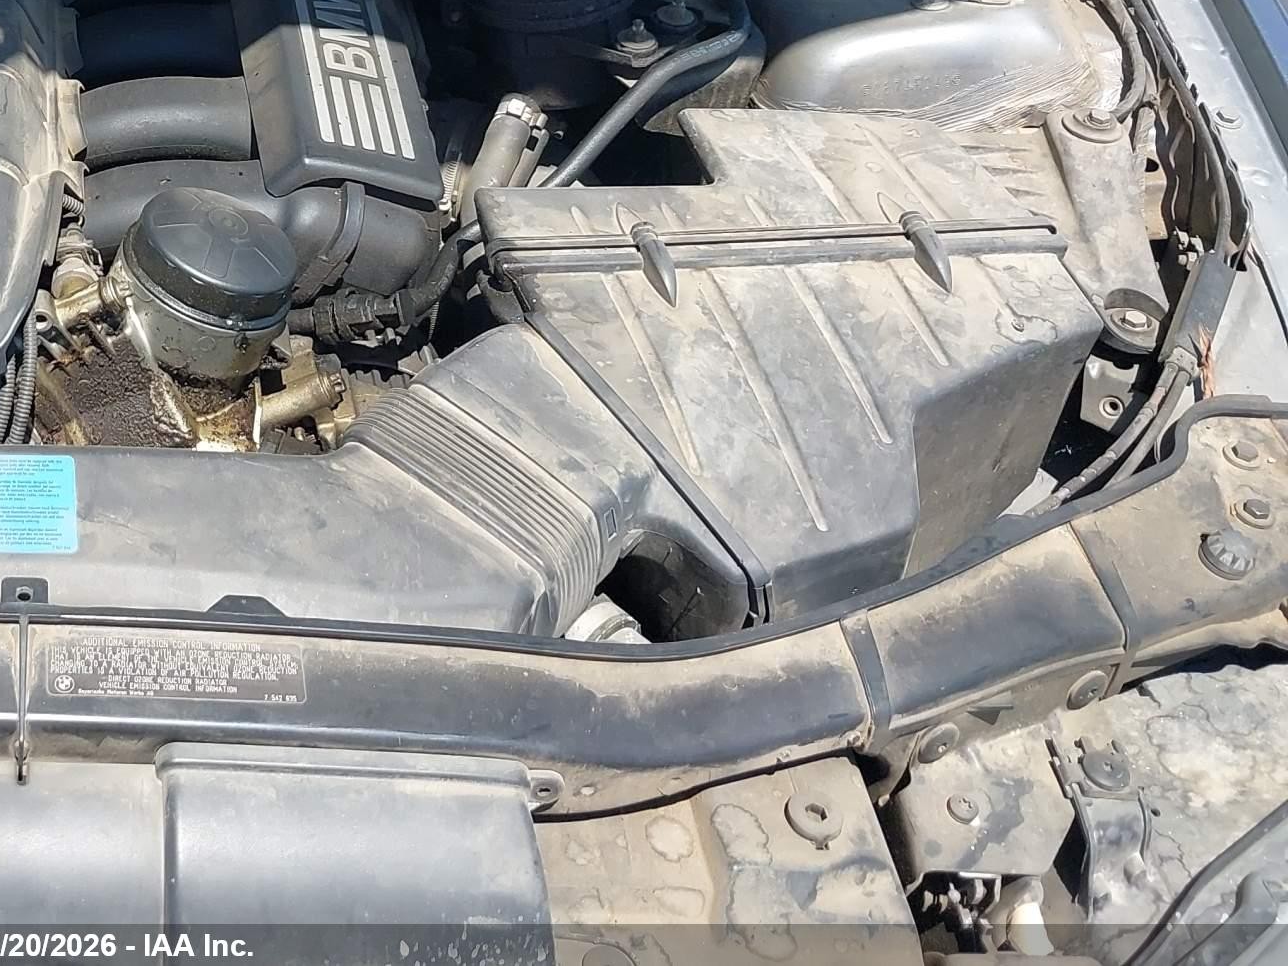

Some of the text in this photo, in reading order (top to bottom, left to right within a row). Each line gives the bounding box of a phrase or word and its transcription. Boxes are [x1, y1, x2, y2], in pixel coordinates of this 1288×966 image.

[82, 638, 261, 652] ADDITIONAL EMISSION CONTROL INFORMATION
[51, 646, 66, 654] THIS
[72, 646, 100, 655] VEHICLE
[116, 648, 149, 656] EQUIPPED
[154, 648, 172, 657] WITH
[176, 650, 186, 658] AN
[189, 650, 210, 658] OZONE
[214, 651, 252, 660] REDUCTION
[99, 654, 130, 662] ELEMENT
[164, 656, 193, 664] VEHICLE
[198, 657, 231, 666] EMISSION
[234, 658, 266, 667] CONTROL
[50, 666, 94, 674] PROPERTIES
[118, 668, 157, 676] VIOLATION
[190, 670, 230, 679] POLLUTION
[232, 672, 279, 681] REGULATION.
[112, 661, 146, 669] RADIATOR
[151, 662, 181, 671] WITHOUT
[186, 663, 230, 672] EQUIVALENT
[234, 665, 255, 674] OZONE
[258, 666, 298, 675] REDUCTION
[130, 682, 160, 690] EMISSION
[163, 684, 191, 692] CONTROL
[195, 685, 238, 693] INFORMATION
[194, 678, 228, 686] RADIATOR
